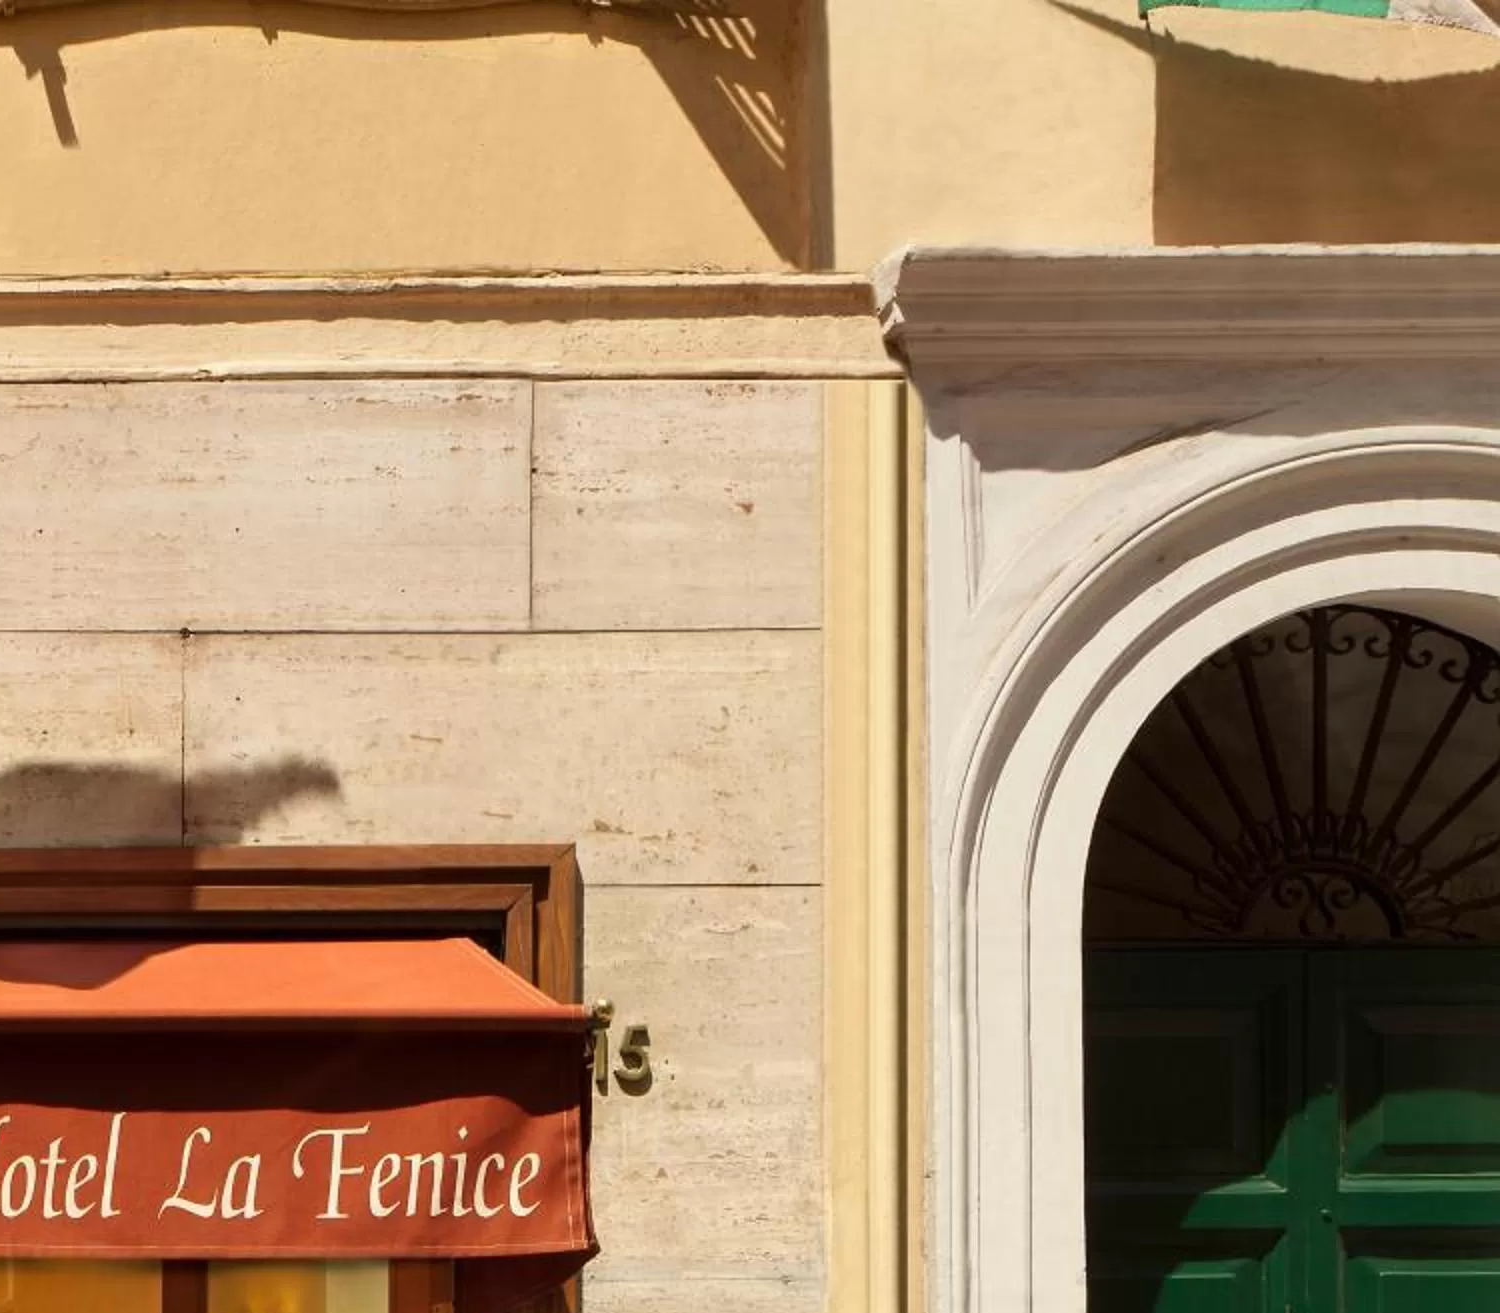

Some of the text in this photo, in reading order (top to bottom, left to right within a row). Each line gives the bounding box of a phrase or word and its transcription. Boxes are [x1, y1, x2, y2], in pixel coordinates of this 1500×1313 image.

[595, 1027, 649, 1081] 15
[158, 1127, 263, 1220] La
[292, 1121, 541, 1219] Fenice
